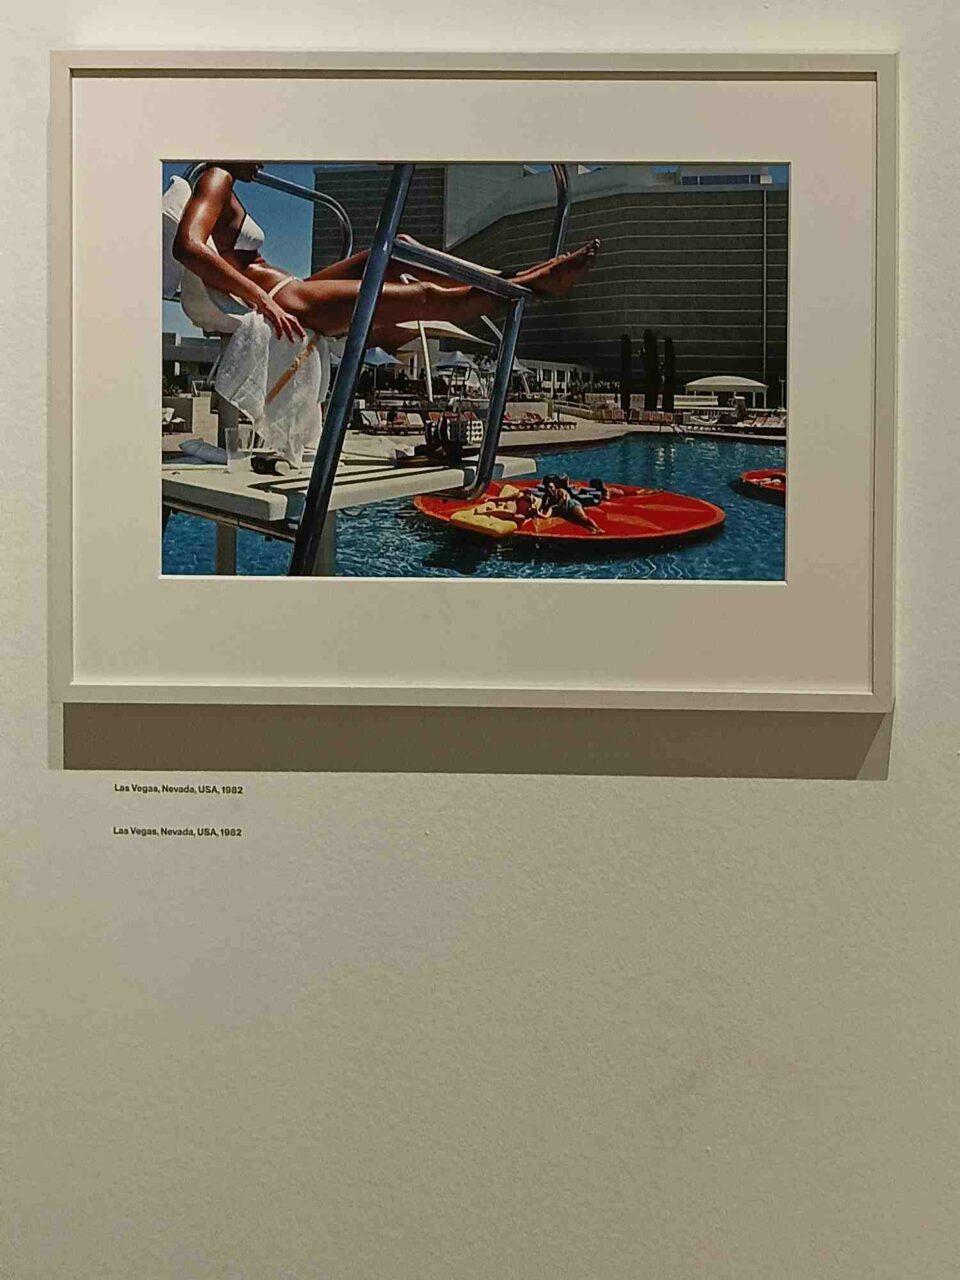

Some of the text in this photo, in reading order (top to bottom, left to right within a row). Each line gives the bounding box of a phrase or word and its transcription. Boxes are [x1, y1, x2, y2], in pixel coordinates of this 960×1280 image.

[114, 783, 243, 795] Las Vegas, Nevada, USA, 1982
[113, 826, 242, 837] Las Vegas, Nevada, USA, 1982
